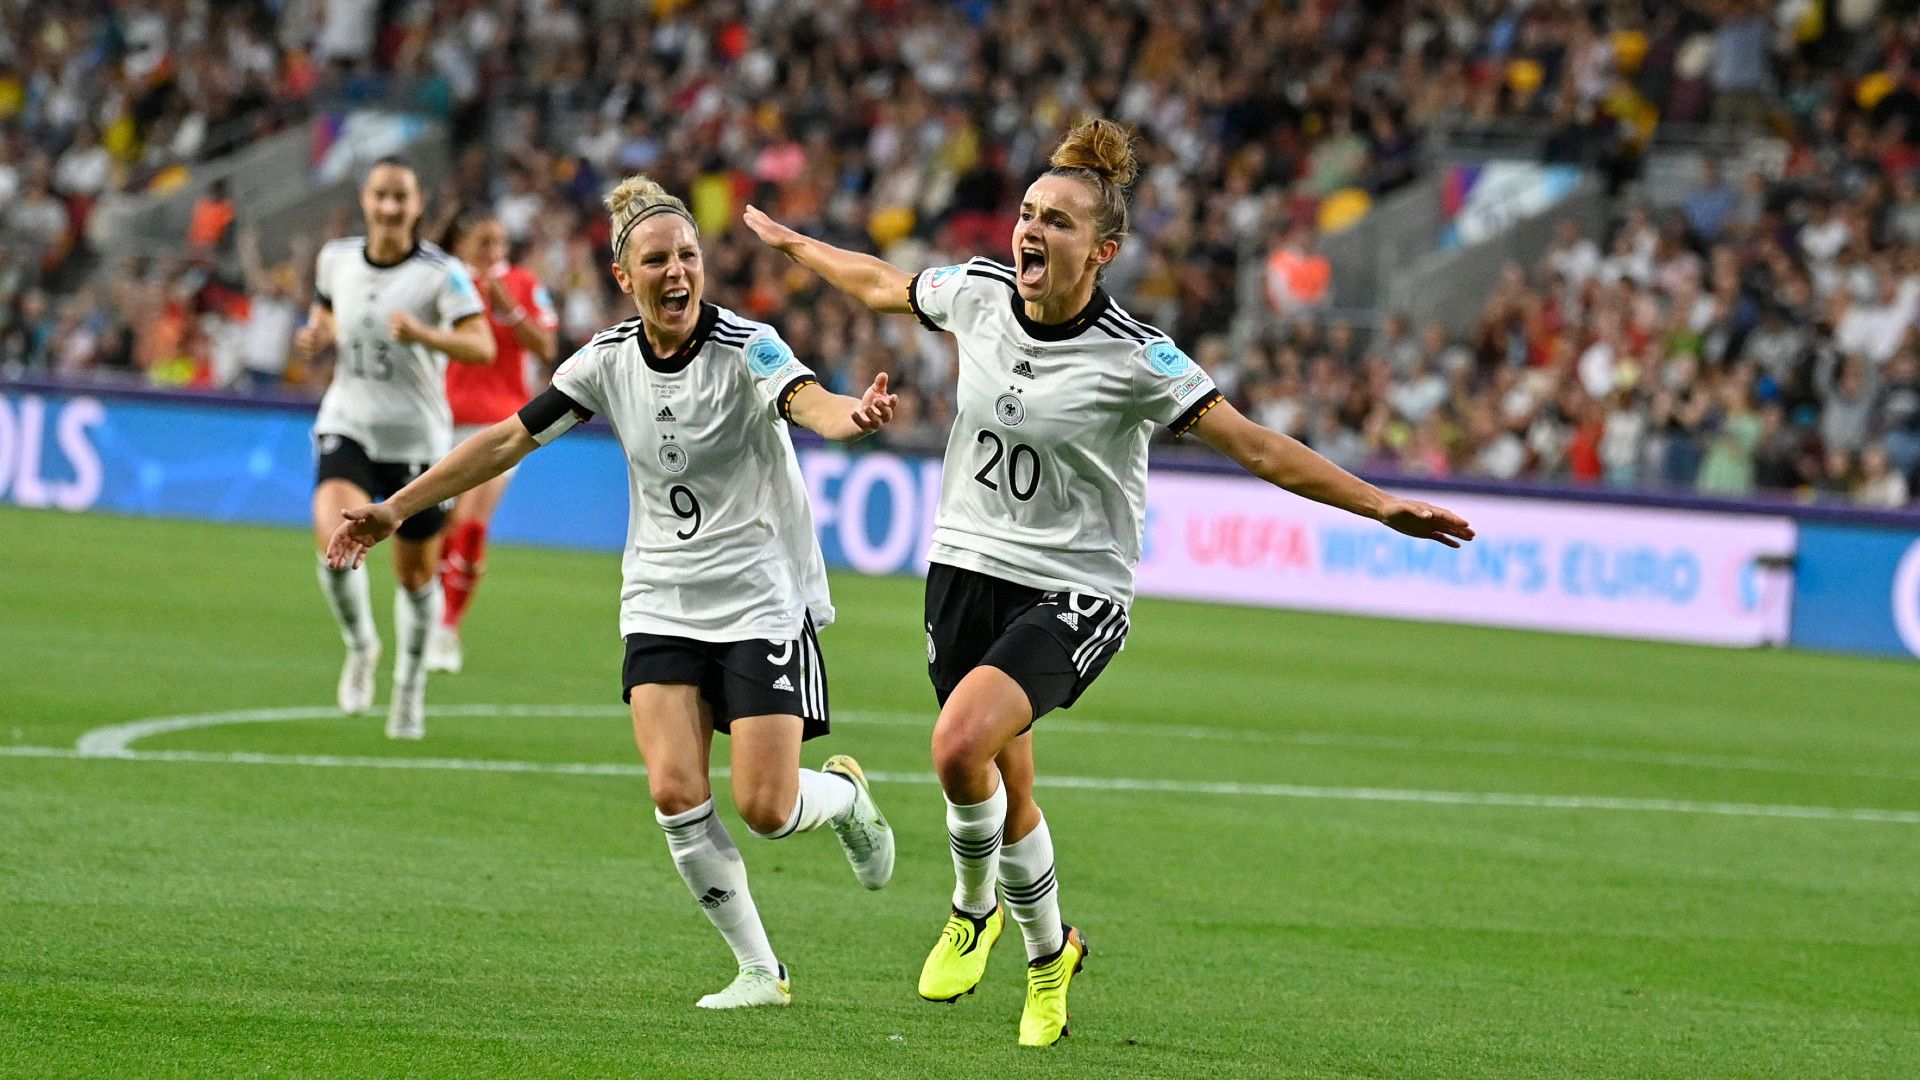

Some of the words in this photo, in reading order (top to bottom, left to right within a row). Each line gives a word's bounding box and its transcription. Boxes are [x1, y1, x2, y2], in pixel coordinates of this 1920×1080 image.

[351, 339, 393, 382] 13
[1012, 368, 1035, 380] adidas
[974, 430, 1041, 501] 20
[670, 485, 701, 540] 9
[1187, 513, 1312, 570] UEFA
[1560, 539, 1701, 604] EURO
[1056, 614, 1079, 631] adidas
[772, 683, 795, 692] adidas
